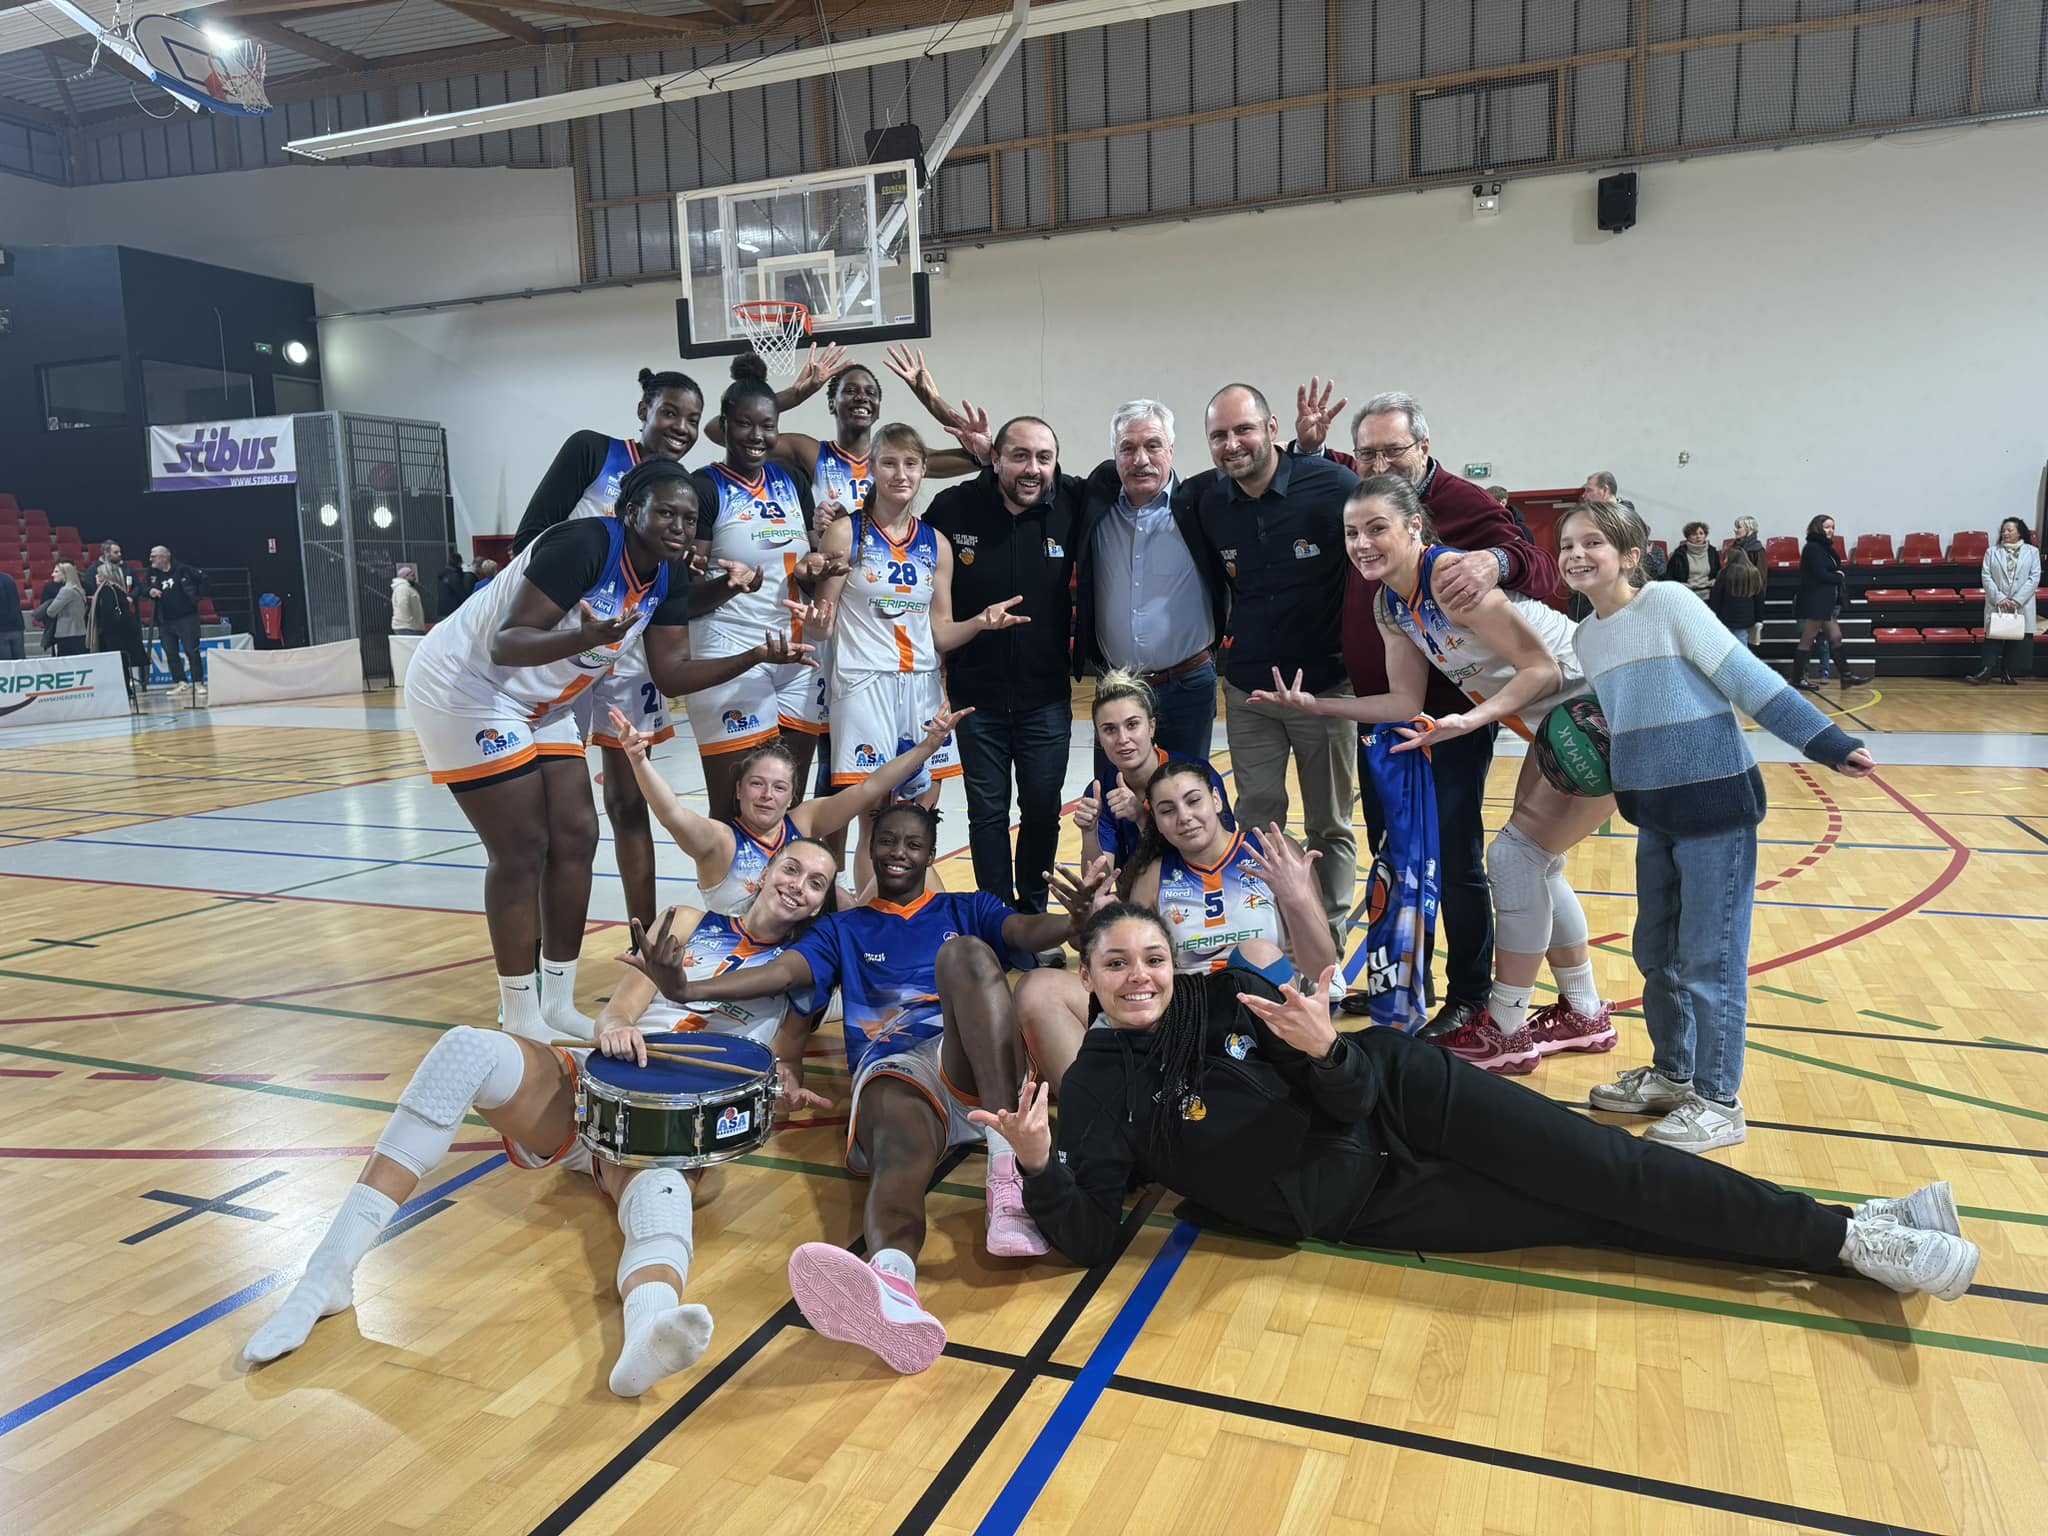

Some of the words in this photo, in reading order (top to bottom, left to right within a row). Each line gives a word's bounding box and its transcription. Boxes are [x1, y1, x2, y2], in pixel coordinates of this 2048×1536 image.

[163, 427, 278, 473] stibus
[754, 500, 786, 519] 23
[887, 561, 918, 586] 28
[593, 600, 613, 613] Nord
[726, 714, 759, 731] ASA
[482, 731, 519, 753] ASA
[856, 753, 886, 764] ASA
[1558, 726, 1601, 787] TARMAK
[1165, 889, 1190, 898] Nord
[1204, 890, 1224, 918] 5
[719, 1114, 746, 1132] ASA
